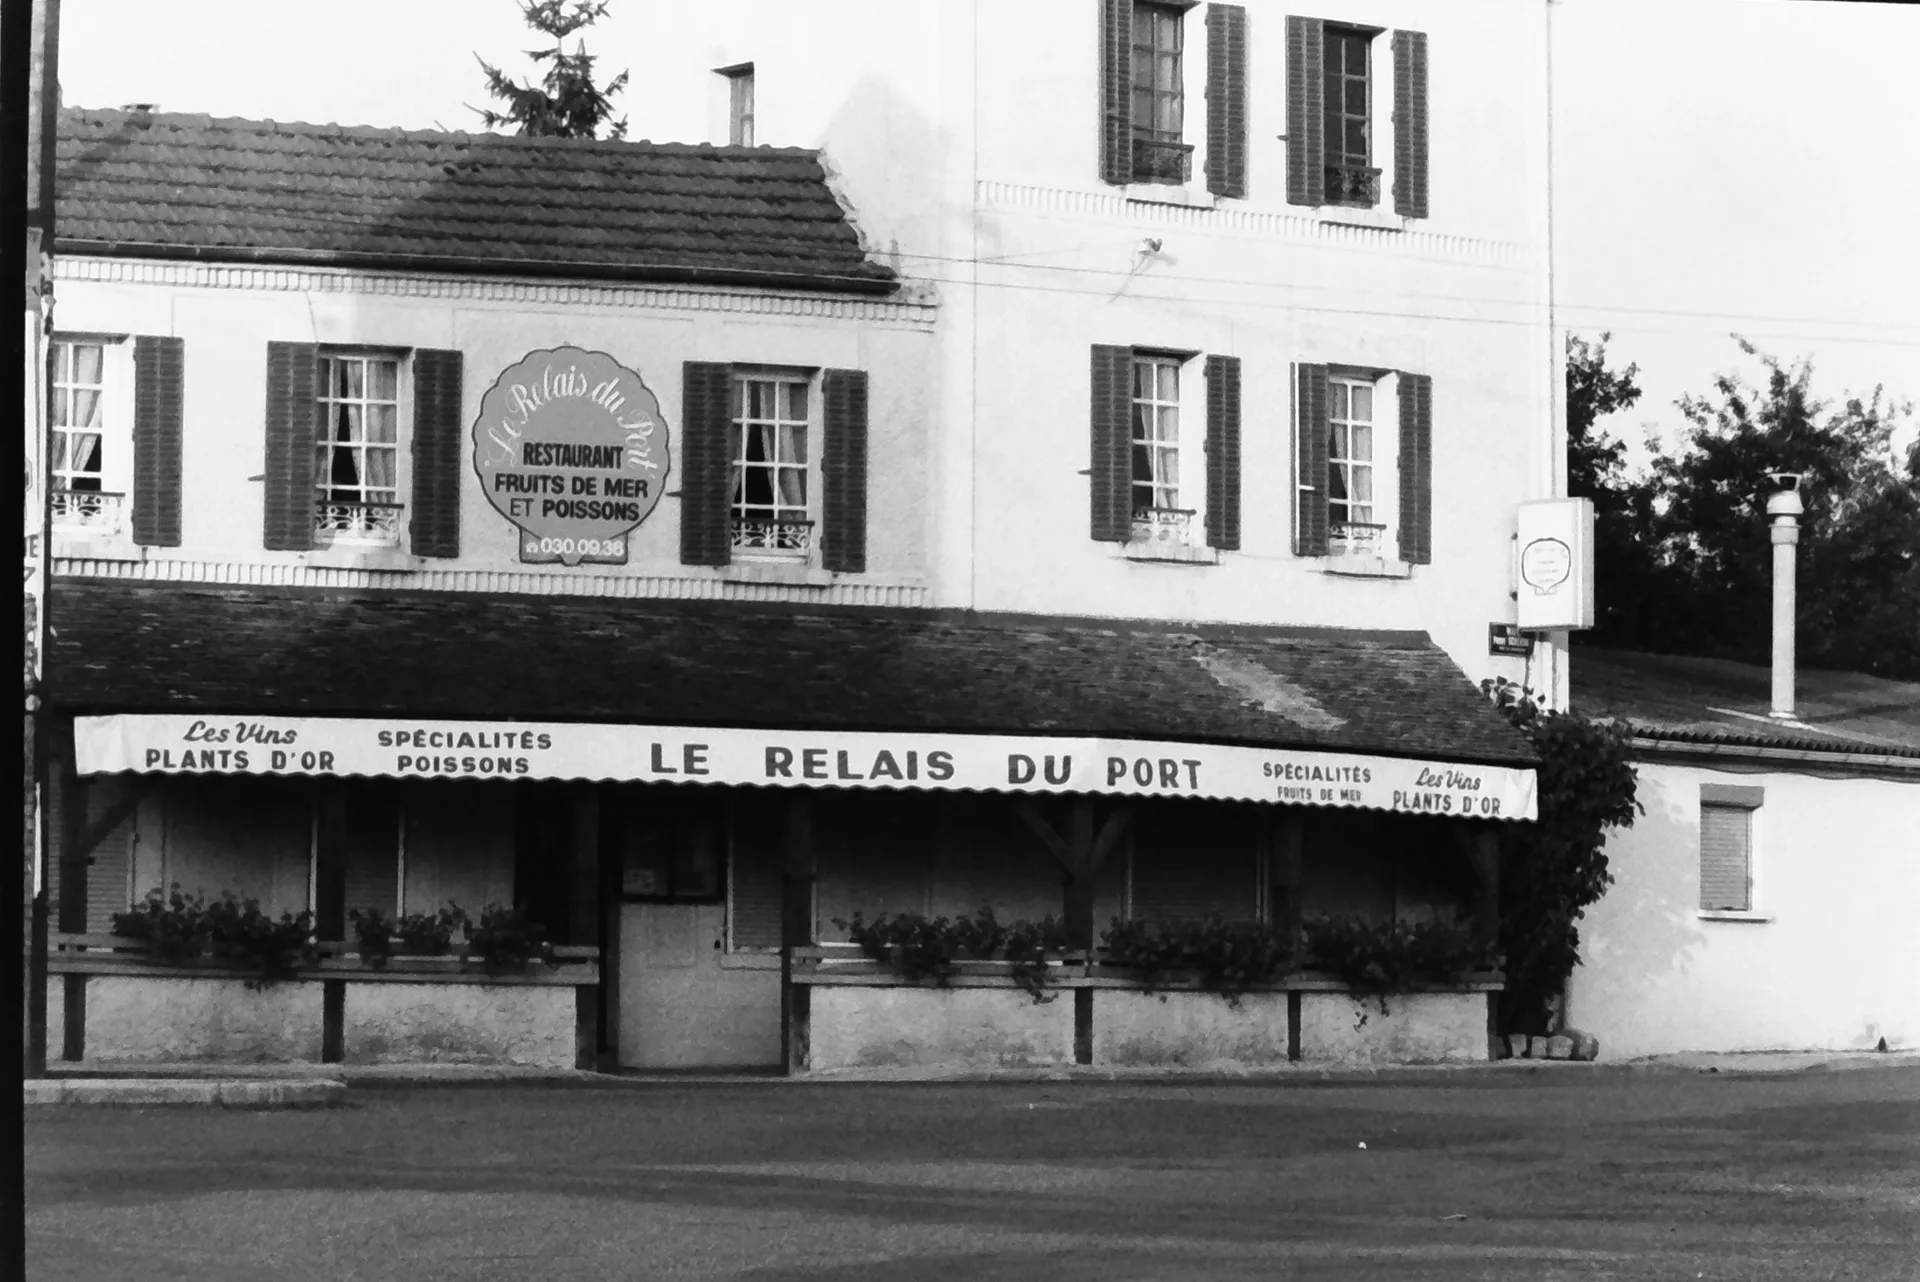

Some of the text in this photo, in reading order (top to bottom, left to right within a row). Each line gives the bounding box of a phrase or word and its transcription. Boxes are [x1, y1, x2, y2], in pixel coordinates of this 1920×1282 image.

[505, 365, 588, 425] Relais
[591, 377, 625, 415] du
[616, 408, 659, 470] Port
[523, 442, 624, 469] RESTAURANT
[495, 473, 649, 498] FRUITS DE MER
[510, 498, 640, 522] ET POISSONS
[183, 720, 298, 744] Les Vins
[377, 729, 552, 750] SPÉCIALITÉS
[146, 748, 335, 770] PLANTS D'OR
[397, 755, 530, 774] POISSONS
[651, 743, 1202, 789] LE RELAIS DU PORT
[1263, 762, 1372, 783] SPÉCIALITÉS
[1415, 766, 1482, 791] Les Vins
[1277, 786, 1362, 801] FRUITS DE MER
[1393, 790, 1501, 815] PLANTS D'OR
